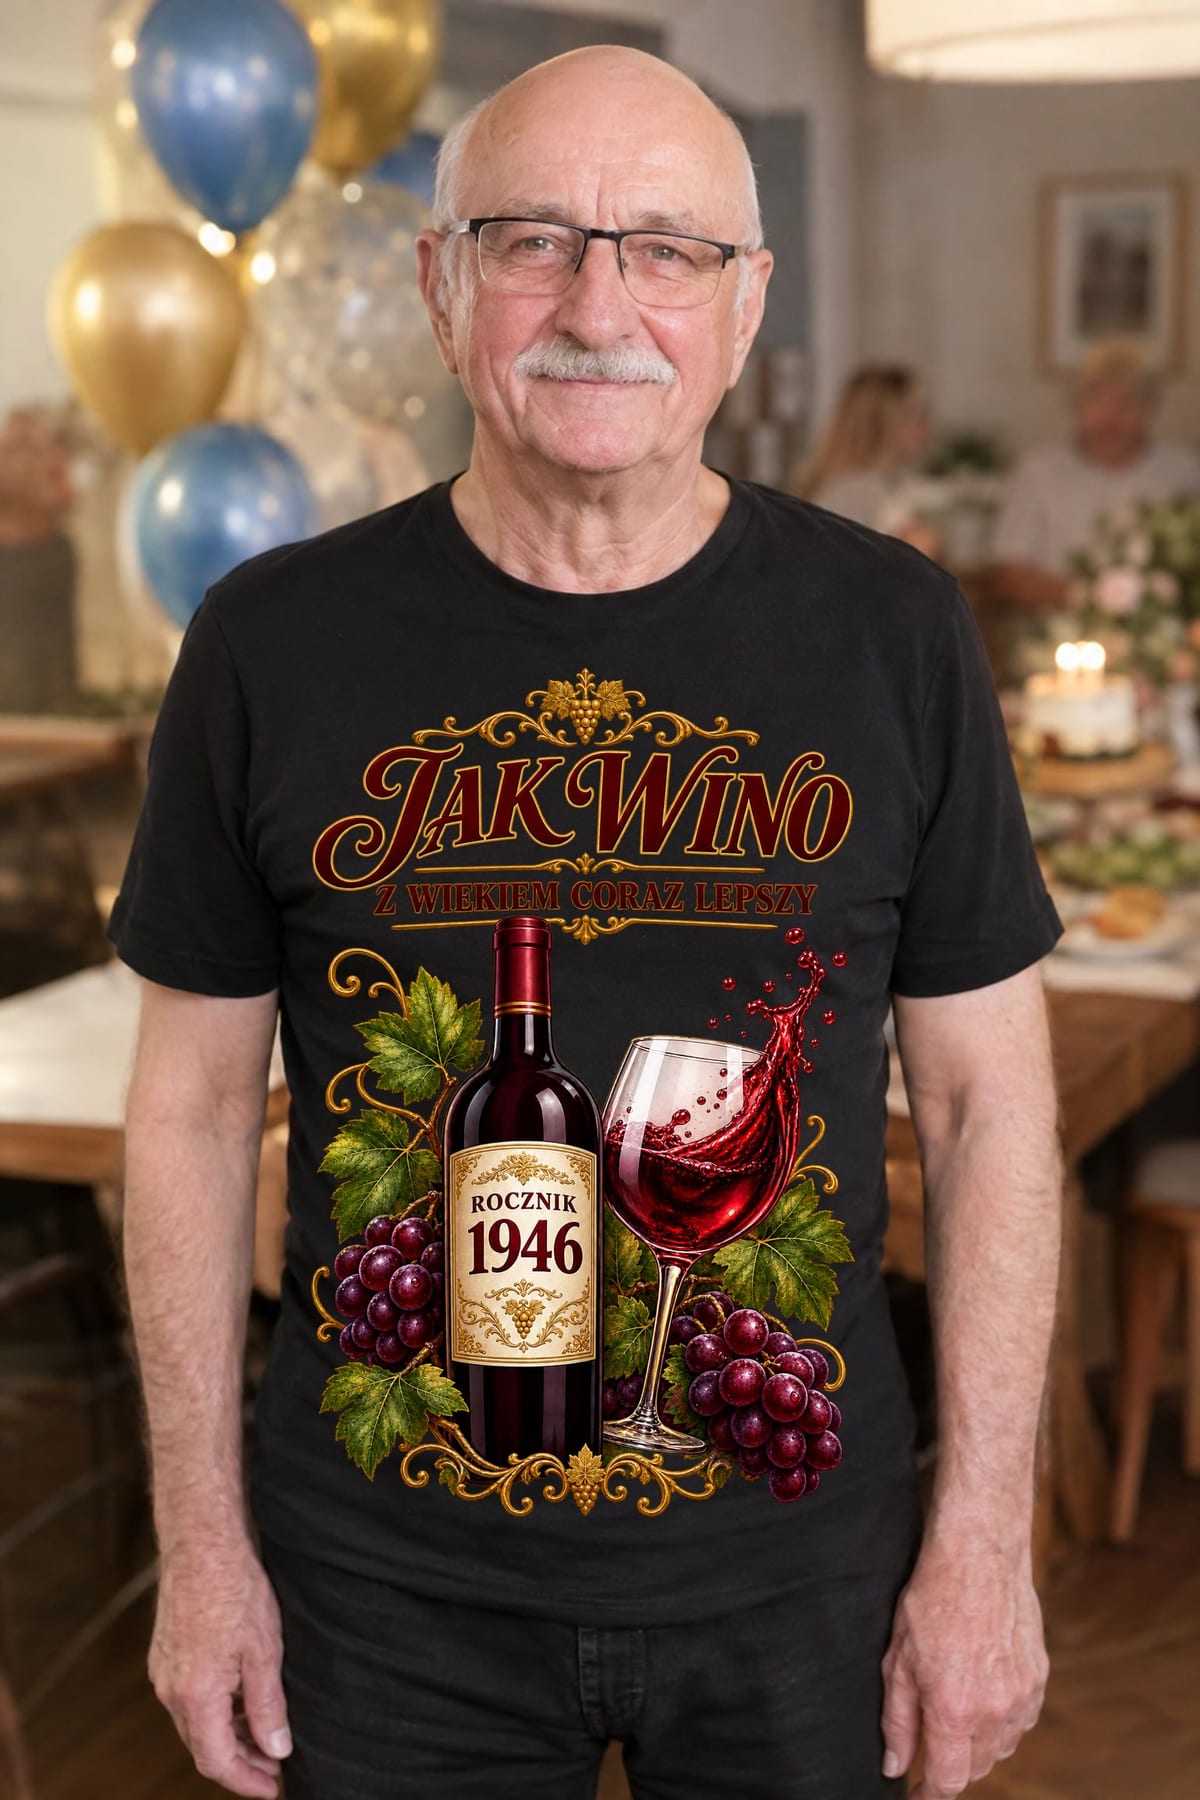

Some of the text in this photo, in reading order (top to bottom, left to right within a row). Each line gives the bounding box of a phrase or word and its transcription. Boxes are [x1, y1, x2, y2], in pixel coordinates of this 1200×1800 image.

[312, 742, 854, 892] JAK WINO
[373, 880, 818, 916] Z WIEKIEM CORAZ LEPSZY
[471, 1192, 577, 1214] ROCZNIK
[467, 1218, 583, 1275] 1946
